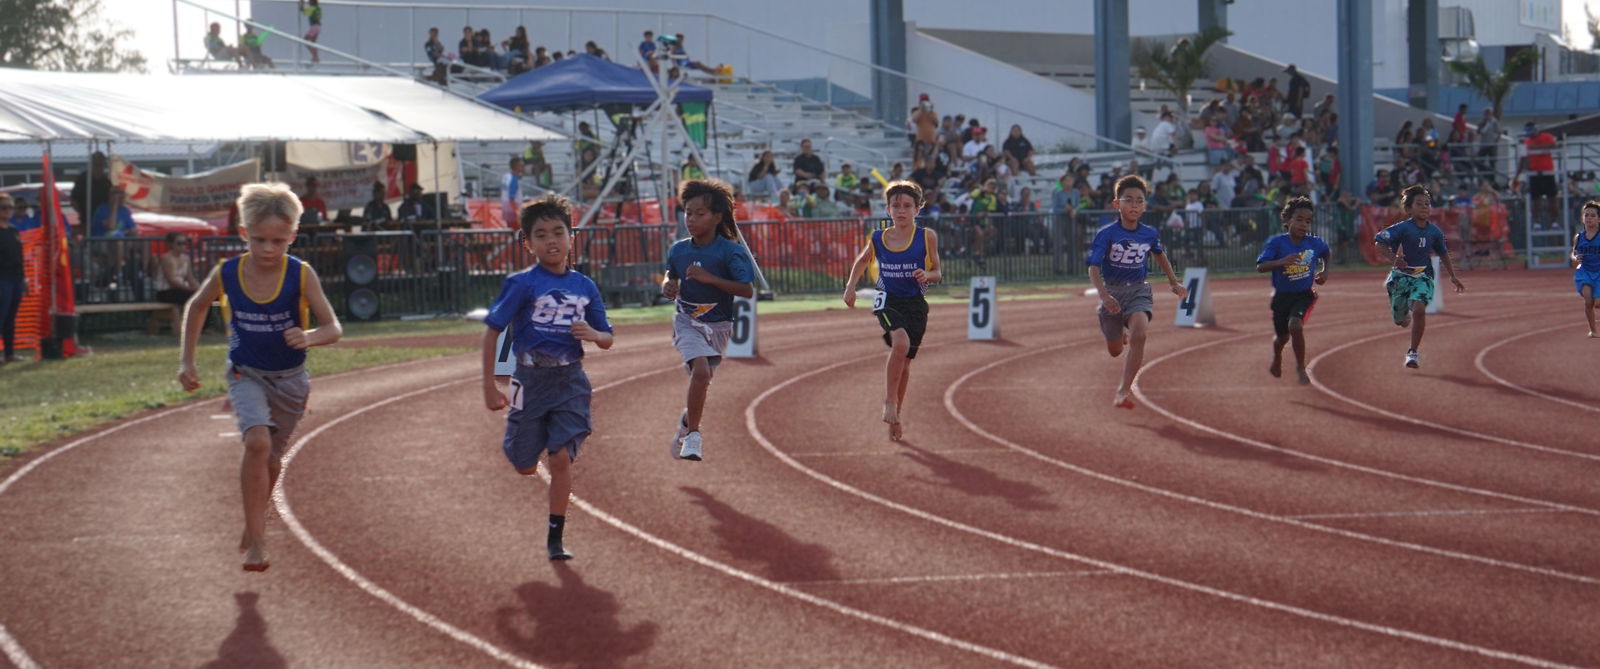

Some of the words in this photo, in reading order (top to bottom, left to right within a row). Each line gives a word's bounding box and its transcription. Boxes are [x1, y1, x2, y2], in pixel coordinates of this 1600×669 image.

[1109, 242, 1151, 264] GES
[531, 294, 590, 325] GES
[972, 287, 990, 328] 5
[1180, 278, 1199, 316] 4
[732, 301, 751, 345] 6
[511, 380, 521, 405] 7
